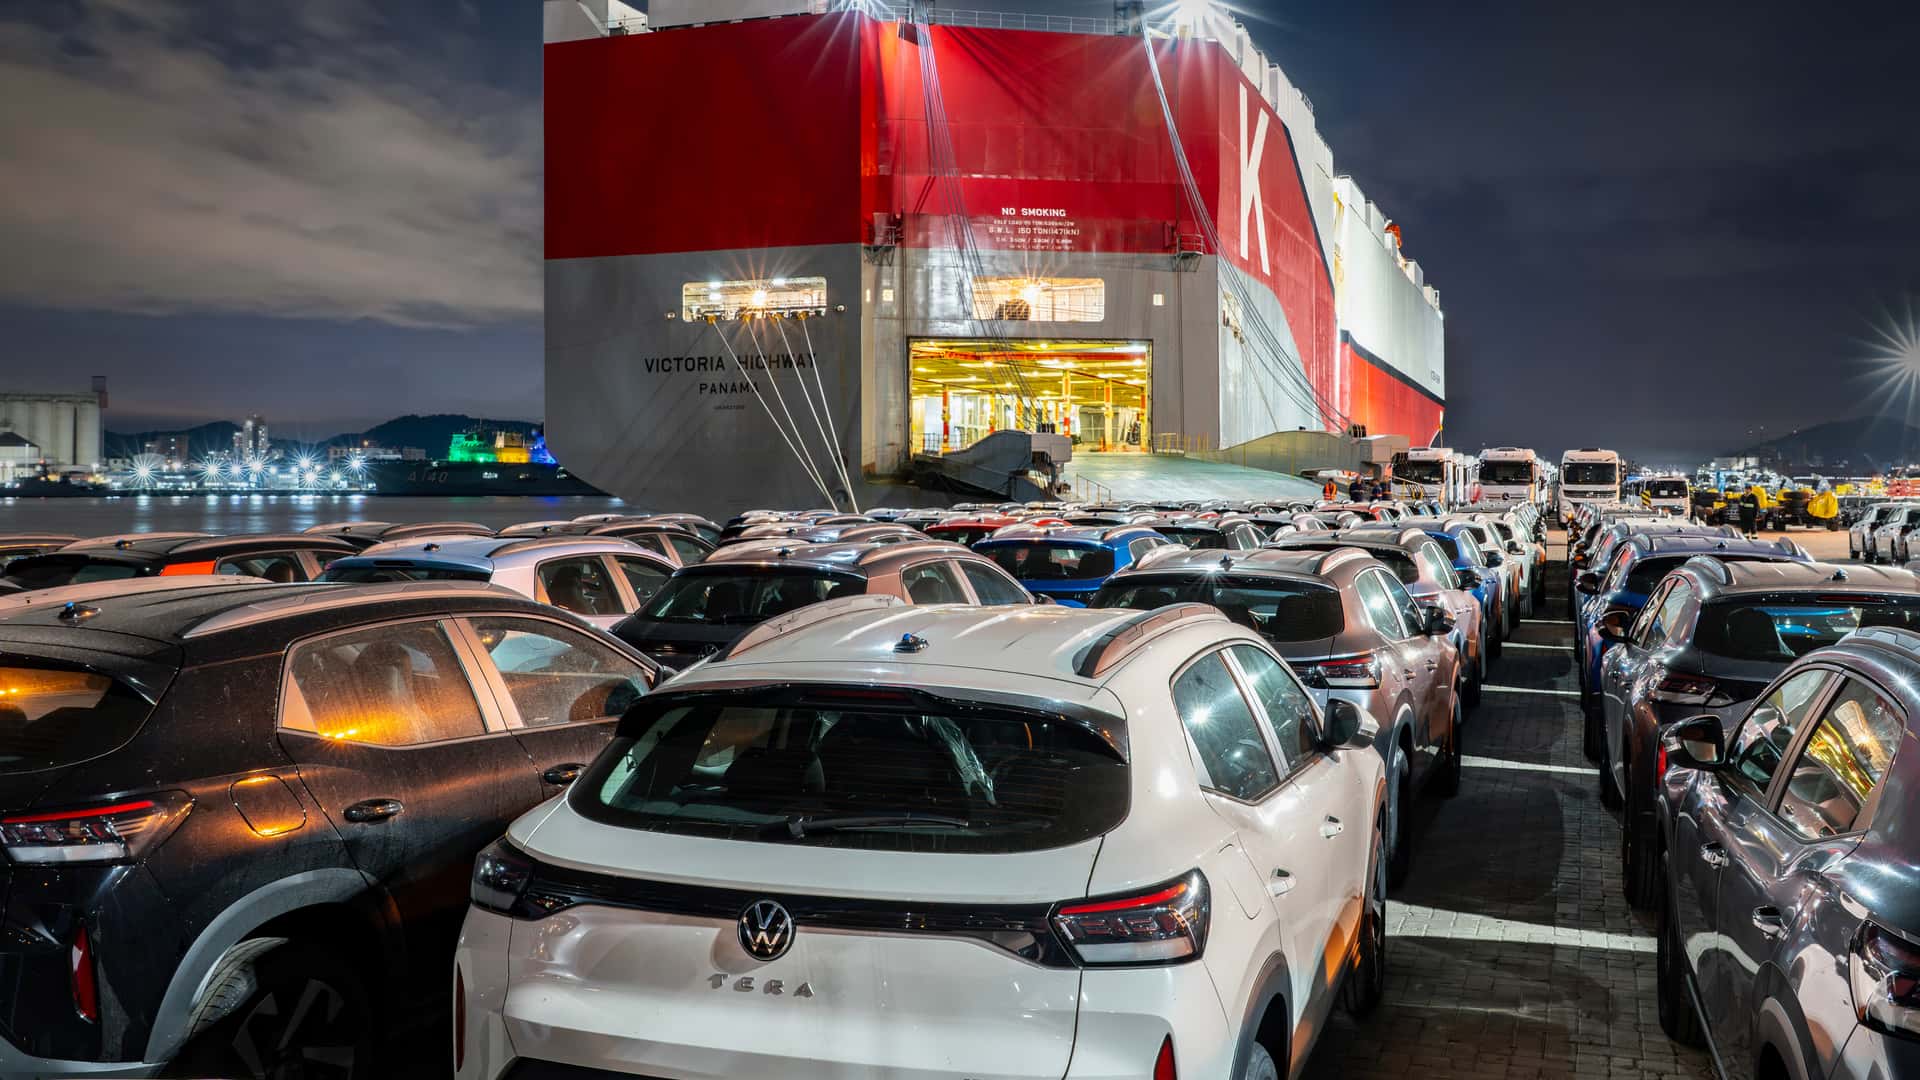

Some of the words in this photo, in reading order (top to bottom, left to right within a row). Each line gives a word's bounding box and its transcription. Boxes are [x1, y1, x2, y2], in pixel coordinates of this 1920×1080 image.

[1239, 81, 1271, 276] K
[1001, 207, 1016, 216] NO
[1021, 208, 1067, 217] SMOKING
[645, 355, 725, 373] VICTORIA
[737, 352, 817, 370] HIGHWAY
[699, 381, 760, 395] PANAMA
[742, 902, 792, 955] VW
[707, 973, 815, 998] TERA
